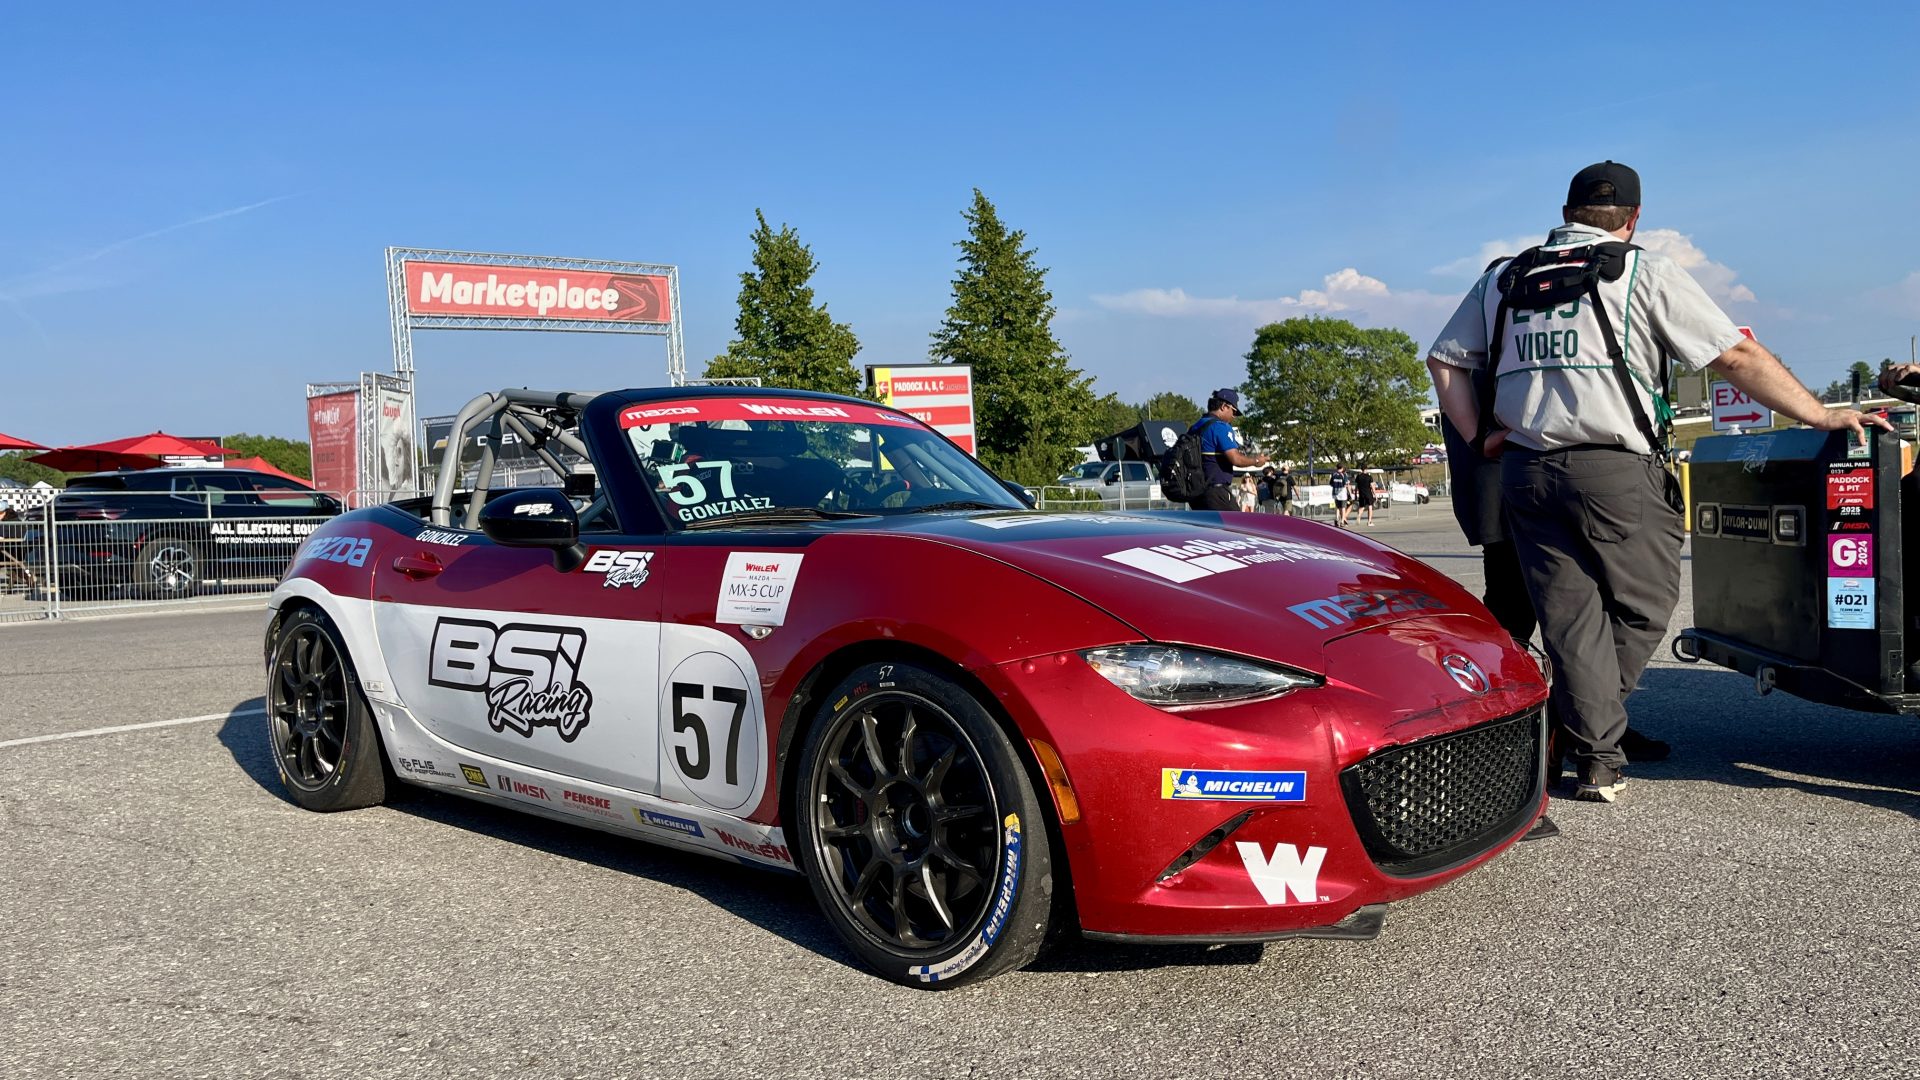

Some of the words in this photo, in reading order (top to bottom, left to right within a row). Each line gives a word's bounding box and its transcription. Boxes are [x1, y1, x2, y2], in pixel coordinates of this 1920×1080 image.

[420, 271, 620, 316] Marketplace
[1514, 329, 1579, 362] VIDEO
[894, 381, 923, 392] PADDOCK
[1715, 388, 1751, 406] EXI
[740, 403, 850, 418] WHELEN
[656, 460, 738, 506] 57
[678, 497, 775, 522] GONZALEZ
[210, 523, 235, 534] ALL
[237, 523, 291, 535] ELECTRIC
[1722, 515, 1768, 530] TAYLOR-DUNN
[415, 530, 468, 546] GONZALEZ
[1832, 538, 1857, 567] G
[1857, 540, 1868, 566] 2024
[745, 562, 780, 573] WHELEN
[603, 567, 650, 589] Racing
[728, 583, 758, 597] MX-5
[759, 584, 784, 598] CUP
[1835, 594, 1868, 605] #021
[879, 665, 893, 680] 57
[487, 677, 592, 740] Racing
[672, 682, 748, 786] 57
[411, 759, 435, 769] FLIS
[415, 769, 456, 778] PERFORMANCE
[464, 768, 485, 783] OMP
[513, 781, 552, 801] IMSA
[1203, 780, 1294, 793] MICHELIN
[563, 790, 611, 809] PENSKE
[652, 817, 696, 832] MICHELIN
[708, 826, 792, 863] WHELEN
[1235, 841, 1328, 905] W
[985, 848, 1018, 940] MICHELIN
